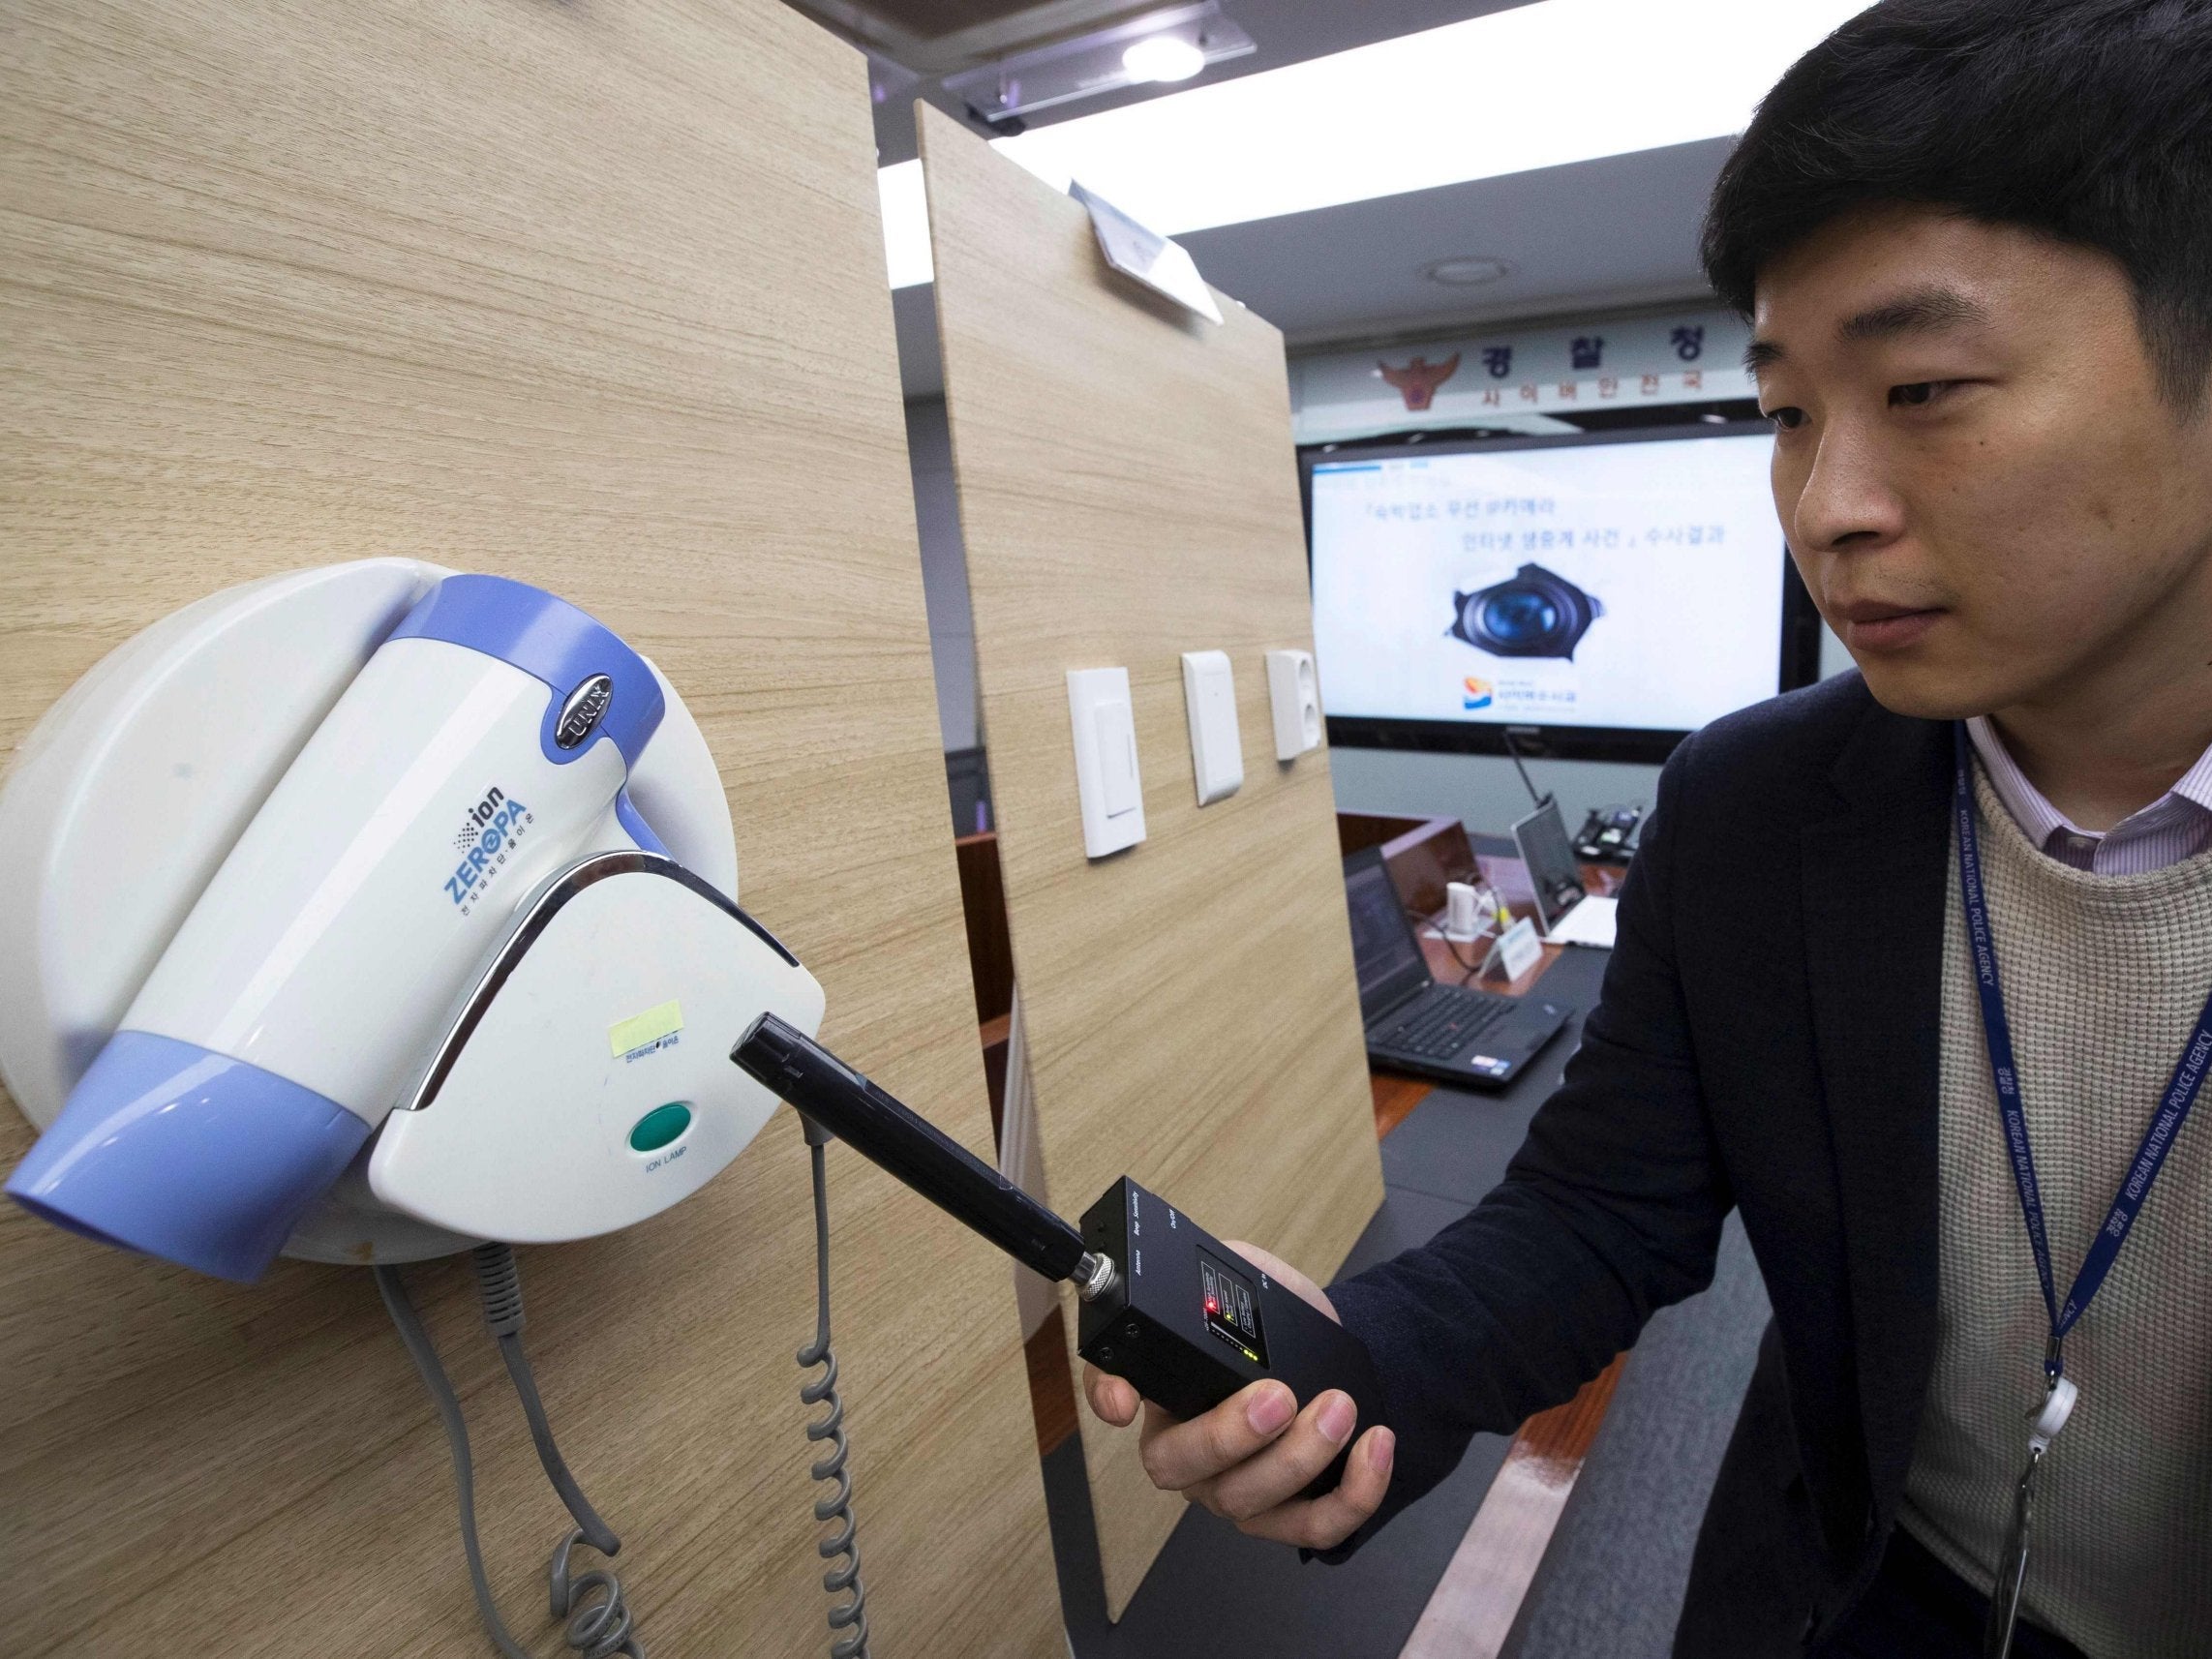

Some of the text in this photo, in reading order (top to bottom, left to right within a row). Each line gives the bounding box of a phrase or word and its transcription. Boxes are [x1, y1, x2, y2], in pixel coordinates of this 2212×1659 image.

[568, 683, 610, 736] UNIX
[468, 786, 505, 829] ion
[443, 799, 528, 905] ZEROPA
[1959, 809, 1973, 852] KOREAN
[1963, 852, 1977, 904] NATIONAL
[1970, 907, 1984, 943] POLICE
[1976, 942, 1994, 987] AGENCY
[2006, 1108, 2025, 1153] KOREAN
[2123, 1029, 2212, 1199] KOREAN NATIONAL POLICE AGENCY
[646, 1146, 688, 1174] ION LAMP
[2015, 1154, 2036, 1208] NATIONAL
